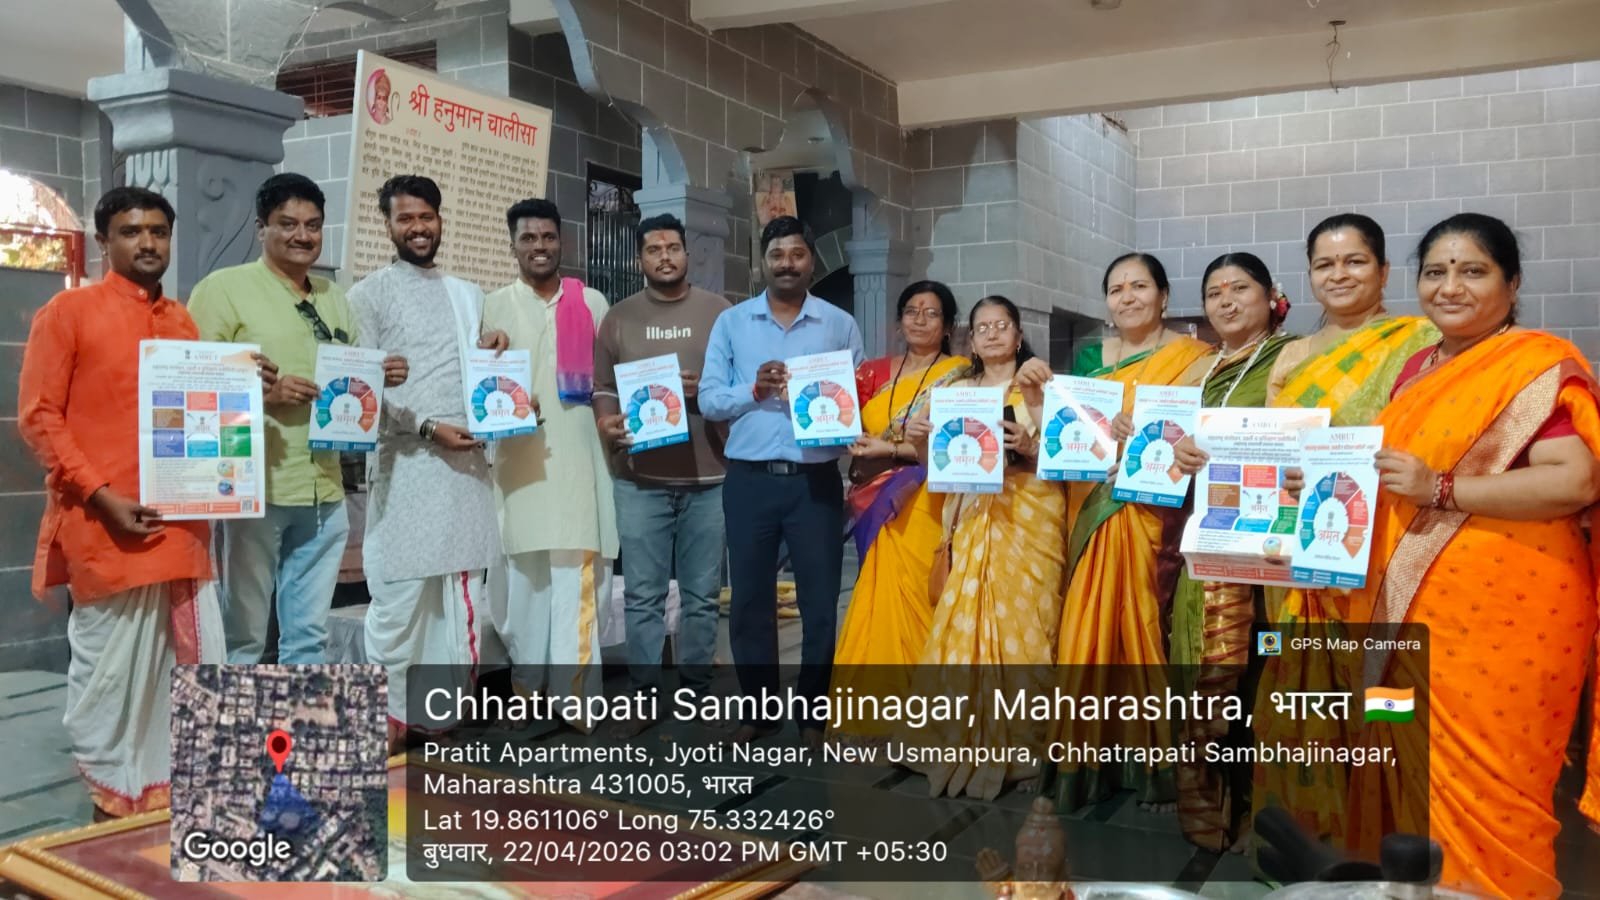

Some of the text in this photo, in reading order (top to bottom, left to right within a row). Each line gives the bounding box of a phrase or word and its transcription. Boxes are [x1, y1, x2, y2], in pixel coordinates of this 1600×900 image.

[408, 84, 538, 147] श्री हनुमान चालीसा
[1330, 432, 1356, 441] AMRUT
[1318, 529, 1341, 546] अमृत
